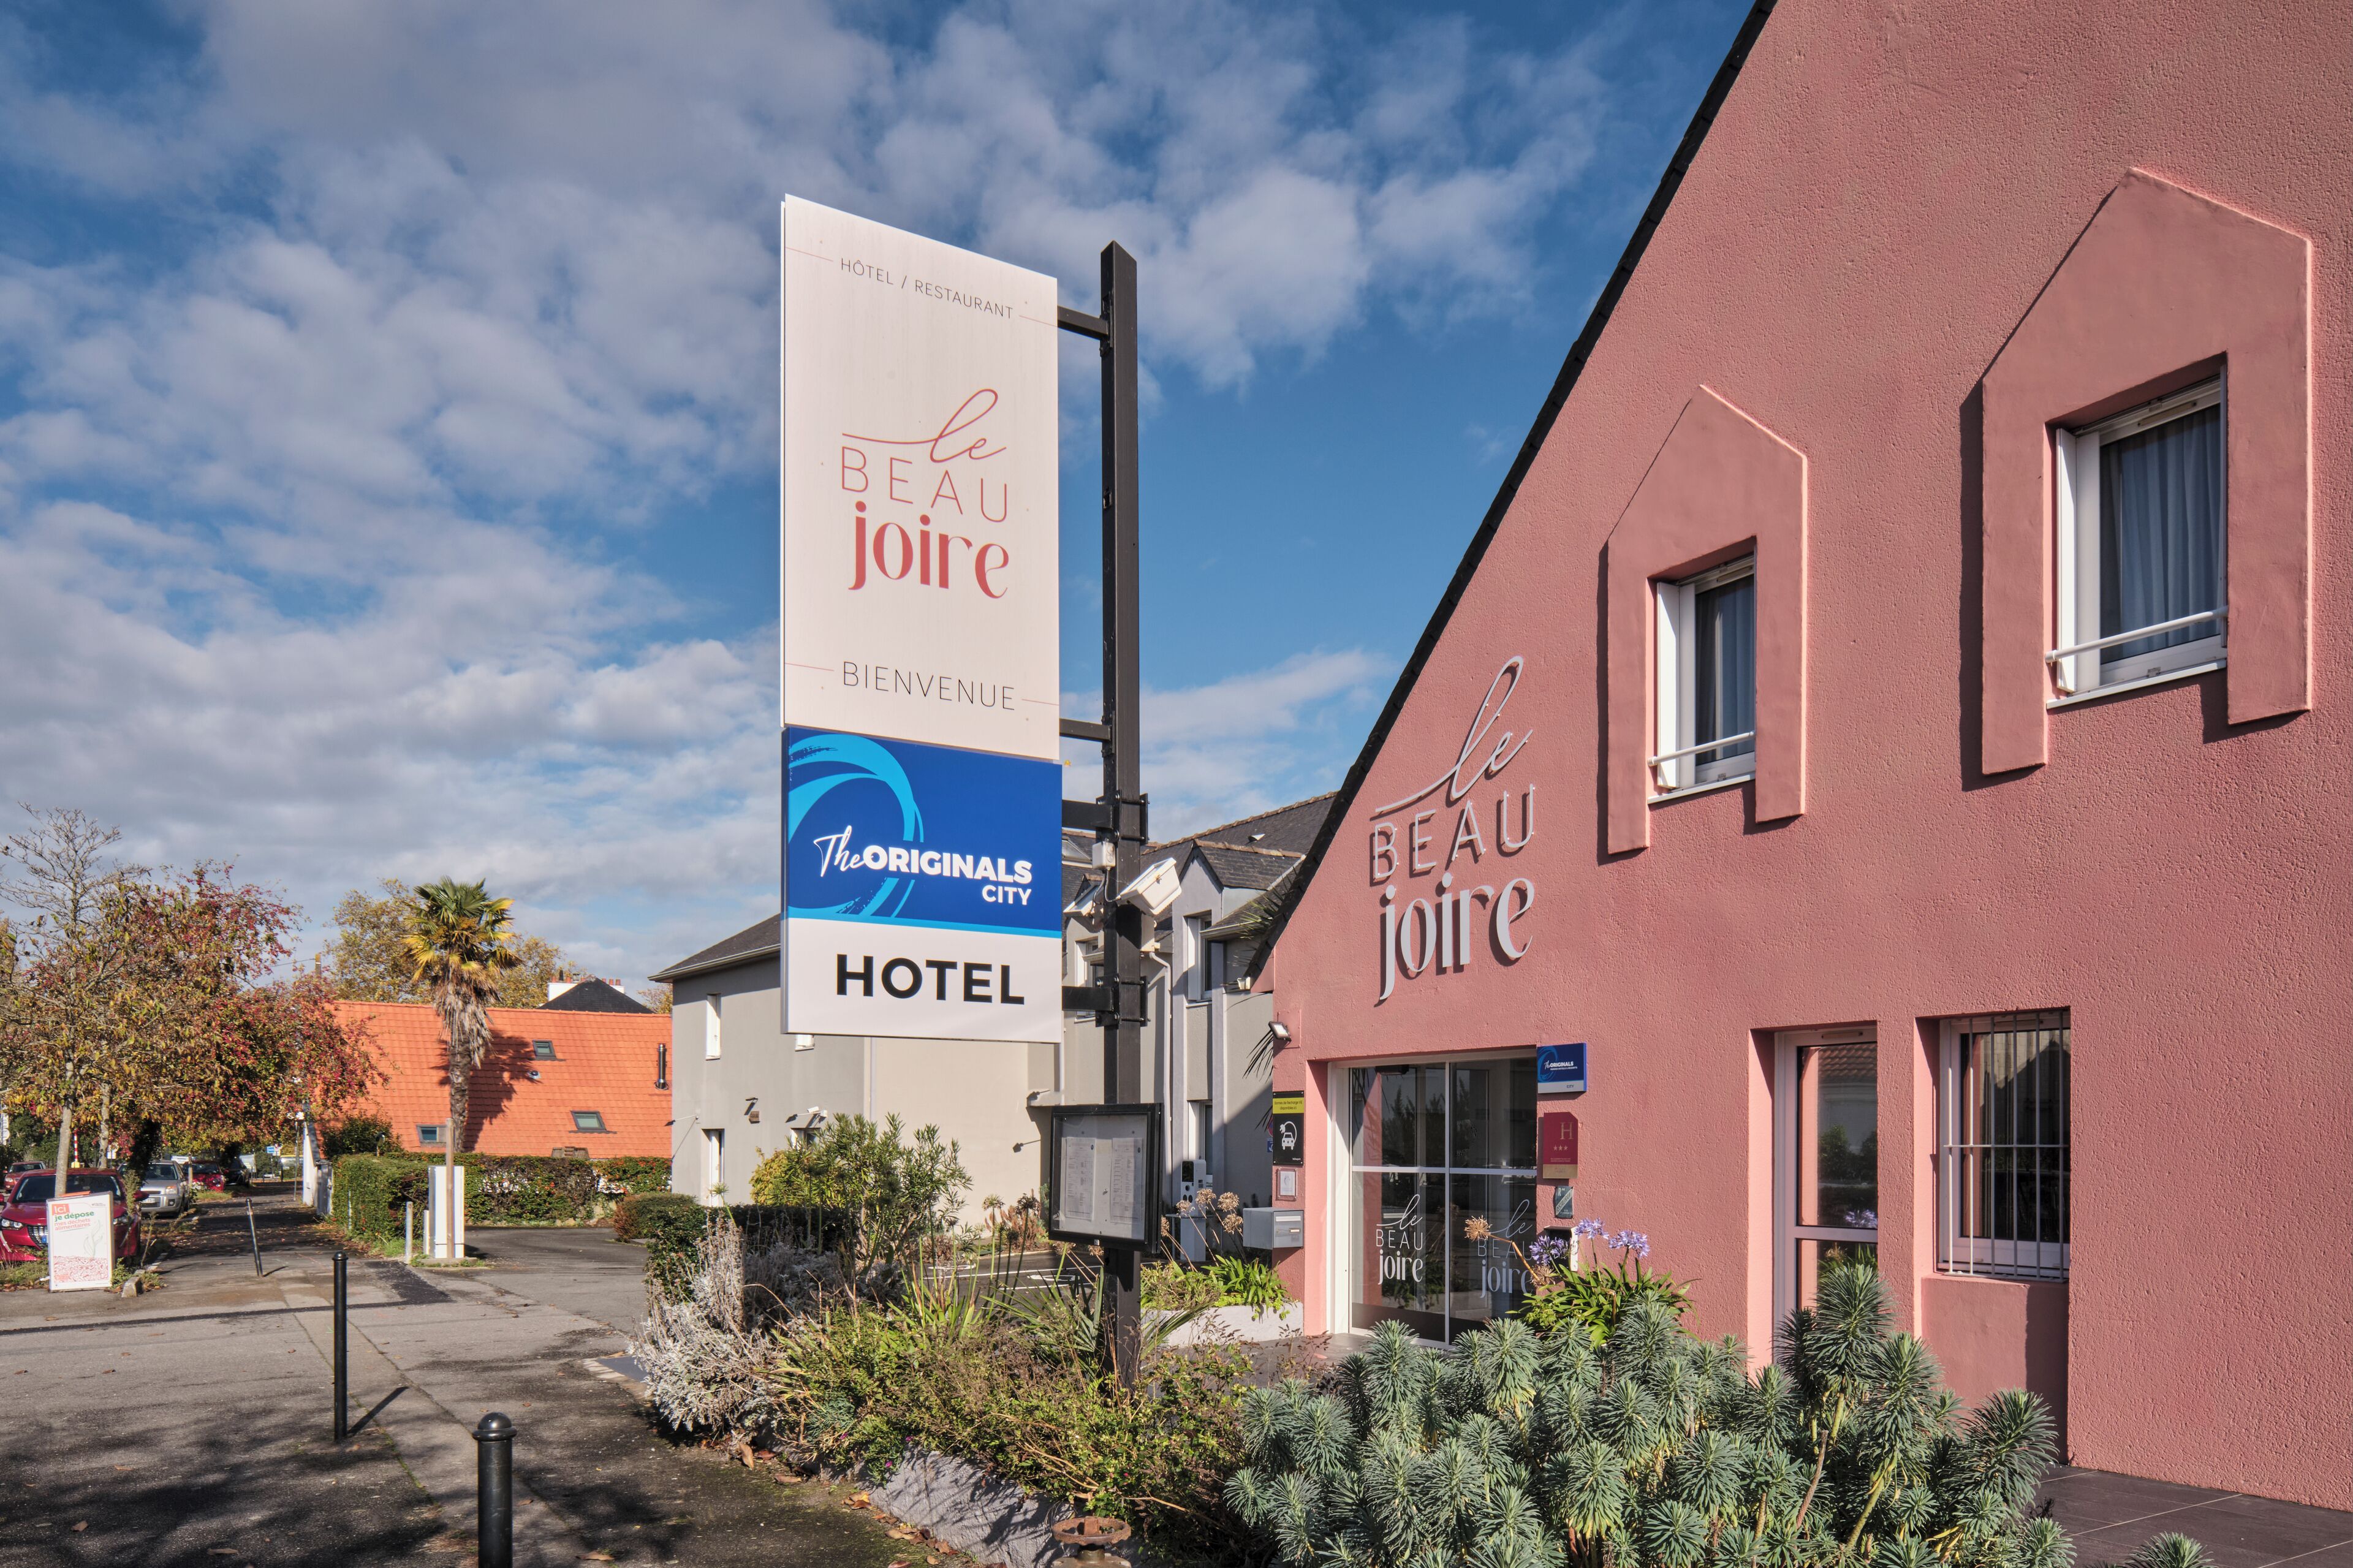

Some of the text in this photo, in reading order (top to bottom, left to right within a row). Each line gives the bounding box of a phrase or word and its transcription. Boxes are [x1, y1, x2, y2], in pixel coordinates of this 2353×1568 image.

[841, 259, 894, 286] HÔTEL
[914, 279, 1014, 319] RESTAURANT
[842, 388, 1007, 463] le
[842, 446, 1007, 523] BEAU
[848, 500, 1009, 599] joire
[843, 661, 1015, 711] BIENVENUE
[1375, 655, 1534, 812] le
[813, 825, 1033, 884] The ORIGINALS
[1374, 782, 1535, 879] BEAU
[982, 884, 1032, 906] CITY
[1379, 871, 1535, 1001] joire
[836, 953, 1025, 1005] HOTEL
[1559, 1122, 1574, 1140] H
[54, 1205, 67, 1214] Ici
[55, 1222, 91, 1231] alimentaires
[64, 1211, 95, 1219] dépose
[1376, 1194, 1423, 1230] le
[1490, 1199, 1533, 1238] le
[1376, 1229, 1423, 1251] BEAU
[1377, 1249, 1423, 1286] joire
